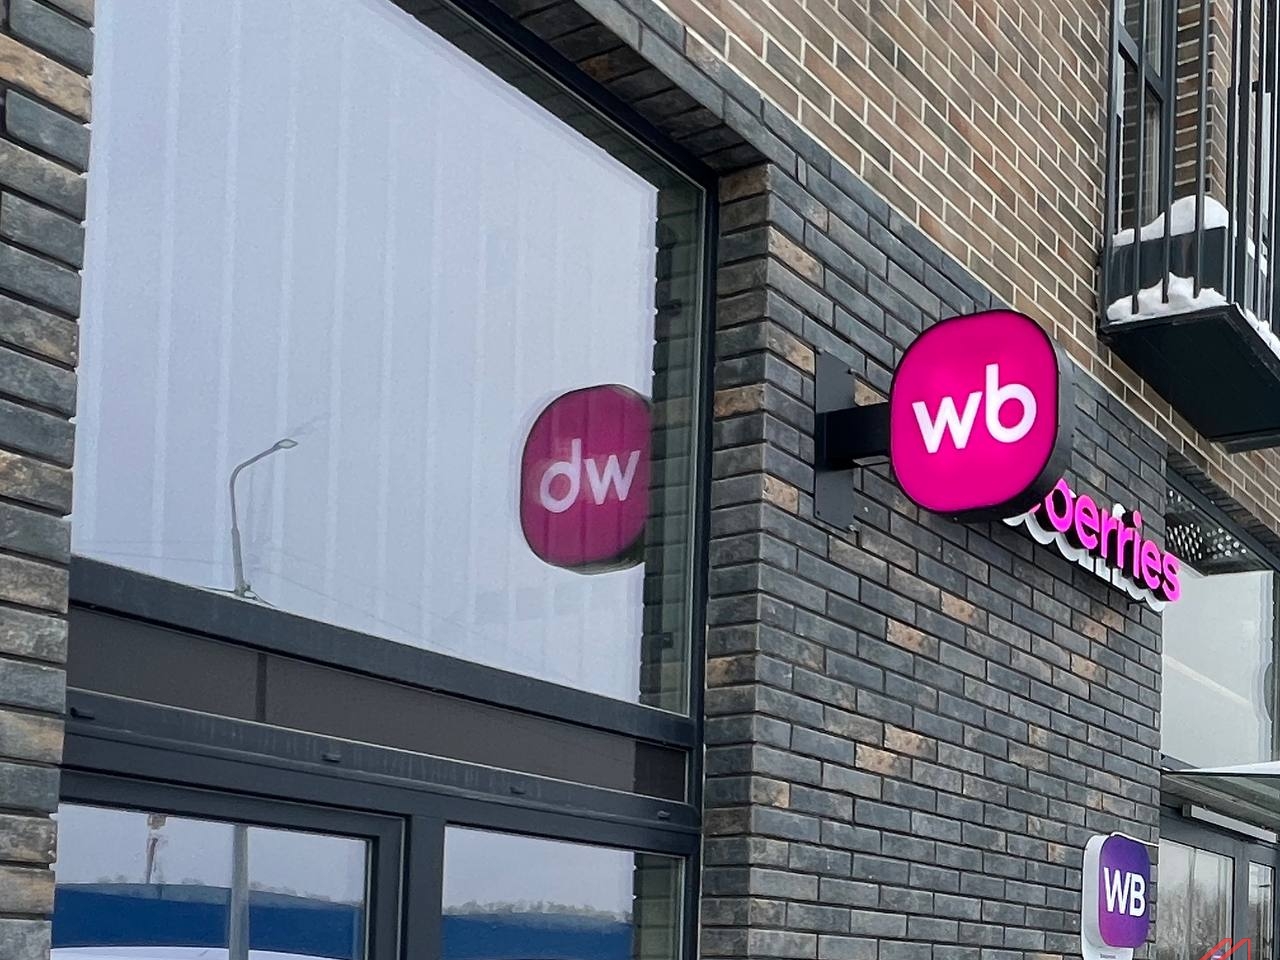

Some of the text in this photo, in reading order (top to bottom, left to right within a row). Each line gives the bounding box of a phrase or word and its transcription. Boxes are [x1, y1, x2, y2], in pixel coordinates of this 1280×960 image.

[911, 363, 1037, 454] wb
[1028, 478, 1182, 602] berries
[1103, 867, 1146, 917] WB
